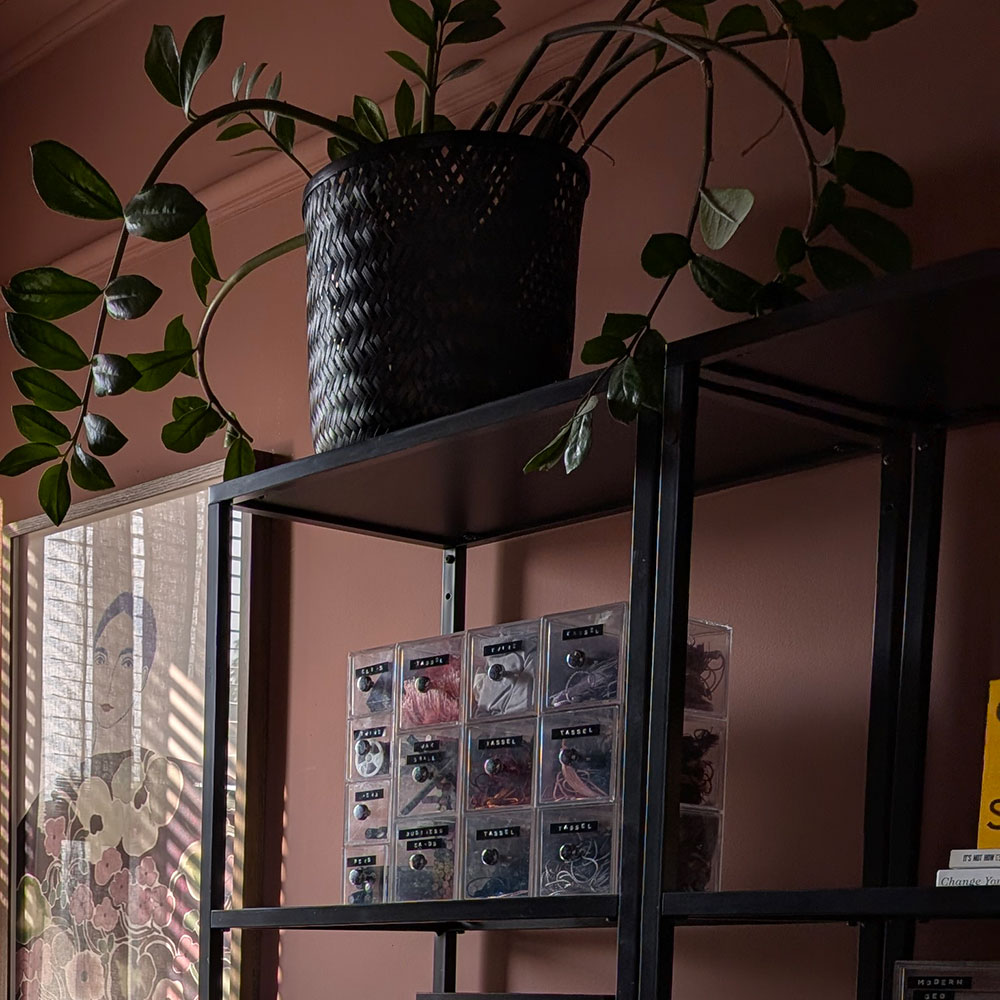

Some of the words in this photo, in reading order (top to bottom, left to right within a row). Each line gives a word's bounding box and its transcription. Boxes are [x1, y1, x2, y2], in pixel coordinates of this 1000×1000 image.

[360, 664, 384, 675] CLIS
[559, 726, 594, 737] TASSEL
[486, 737, 516, 747] TASSEL
[557, 822, 593, 832] TASSEL
[405, 827, 444, 838] BUSIESS
[483, 828, 515, 838] TASSEL
[413, 840, 438, 849] CADS
[940, 876, 983, 888] Change
[916, 978, 964, 987] MODERN
[923, 992, 946, 1000] GEO
